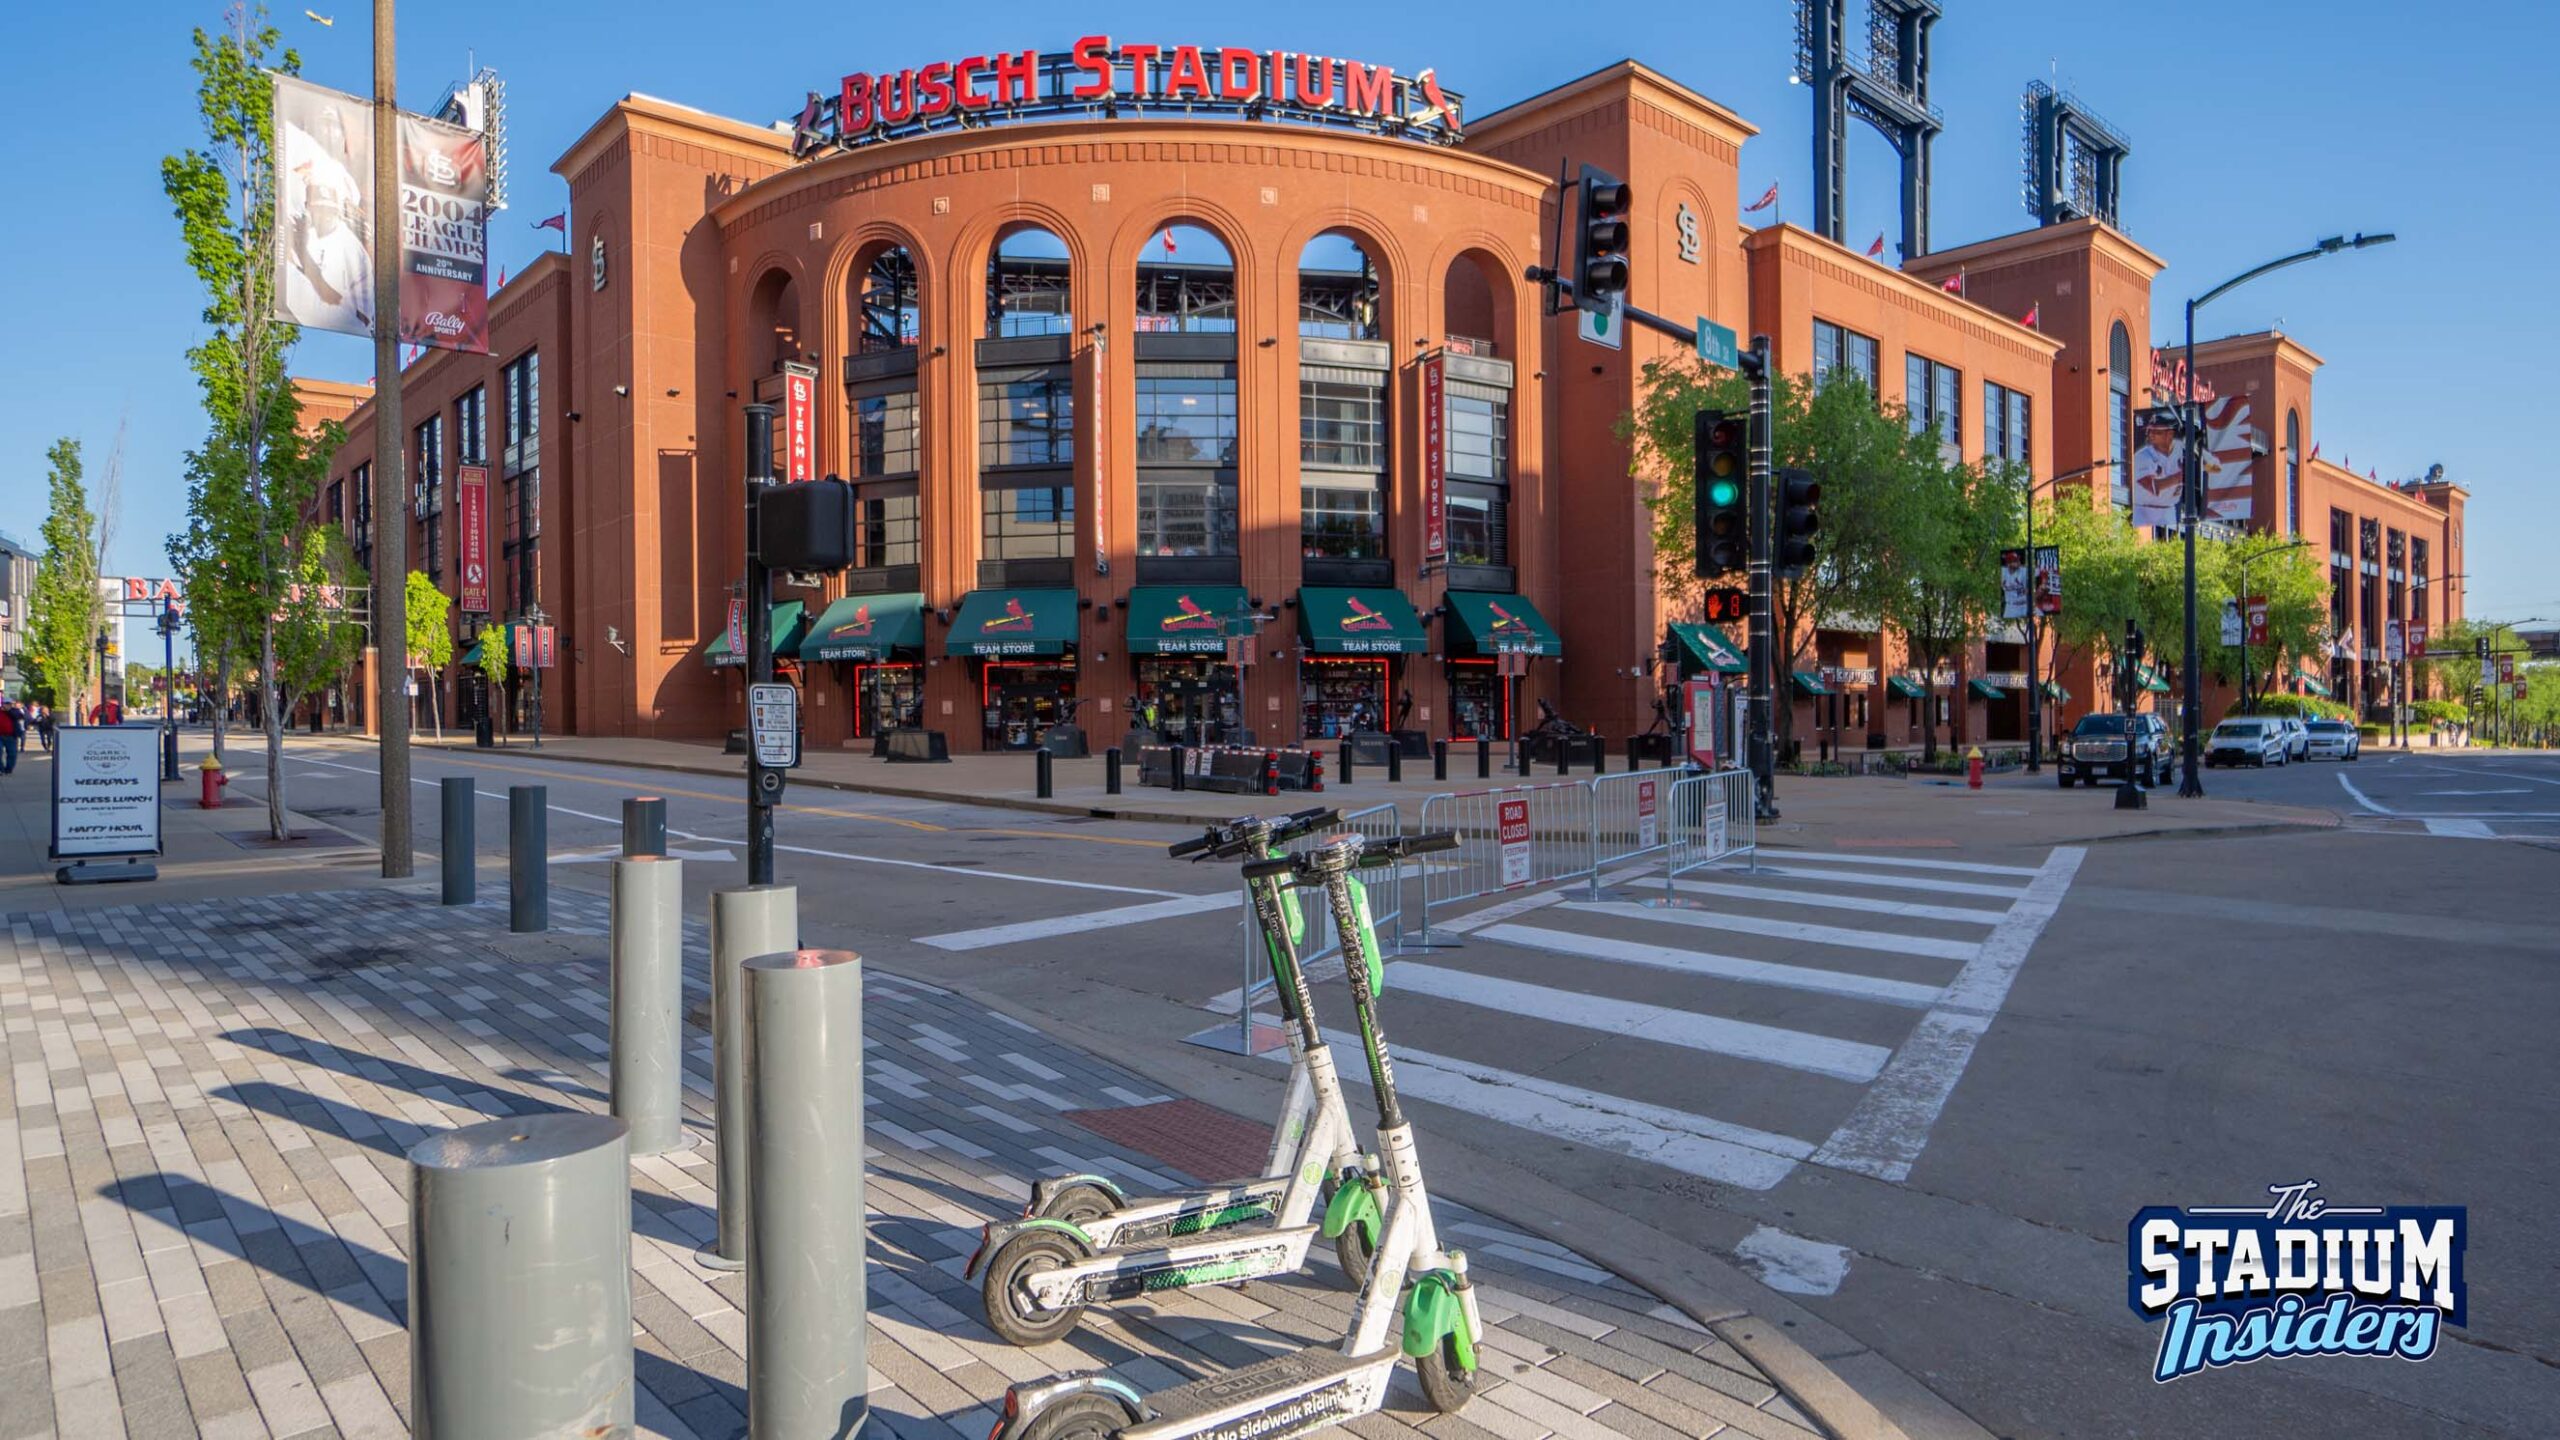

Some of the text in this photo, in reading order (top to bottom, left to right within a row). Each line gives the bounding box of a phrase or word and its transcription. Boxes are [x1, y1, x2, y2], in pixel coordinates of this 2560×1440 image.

[841, 35, 1394, 138] BUSCH STADIUM
[403, 188, 483, 227] 2004
[404, 213, 483, 242] LEAGUE
[404, 230, 483, 259] CHAMPS
[436, 258, 454, 268] 20TH
[416, 264, 473, 282] ANNIVERSARY
[425, 311, 465, 333] Bally
[434, 326, 457, 336] SPORTS
[1705, 326, 1720, 358] 8th
[1430, 392, 1438, 444] TEAM
[795, 406, 805, 459] TEAM
[464, 587, 480, 597] GATE
[820, 650, 842, 659] TEAM
[974, 645, 1035, 655] TEAM STORE
[1158, 642, 1223, 652] TEAM STORE
[1343, 643, 1401, 652] TEAM STORE
[1498, 645, 1520, 654] TEM
[60, 795, 153, 804] EXPRESS LUNCH
[1504, 806, 1523, 820] ROAD
[68, 824, 143, 833] HAPPY HOUR
[1503, 823, 1528, 839] CLOSED
[1296, 975, 1316, 1018] Lime
[1218, 1429, 1238, 1440] No
[1240, 1405, 1304, 1438] Sidewalk
